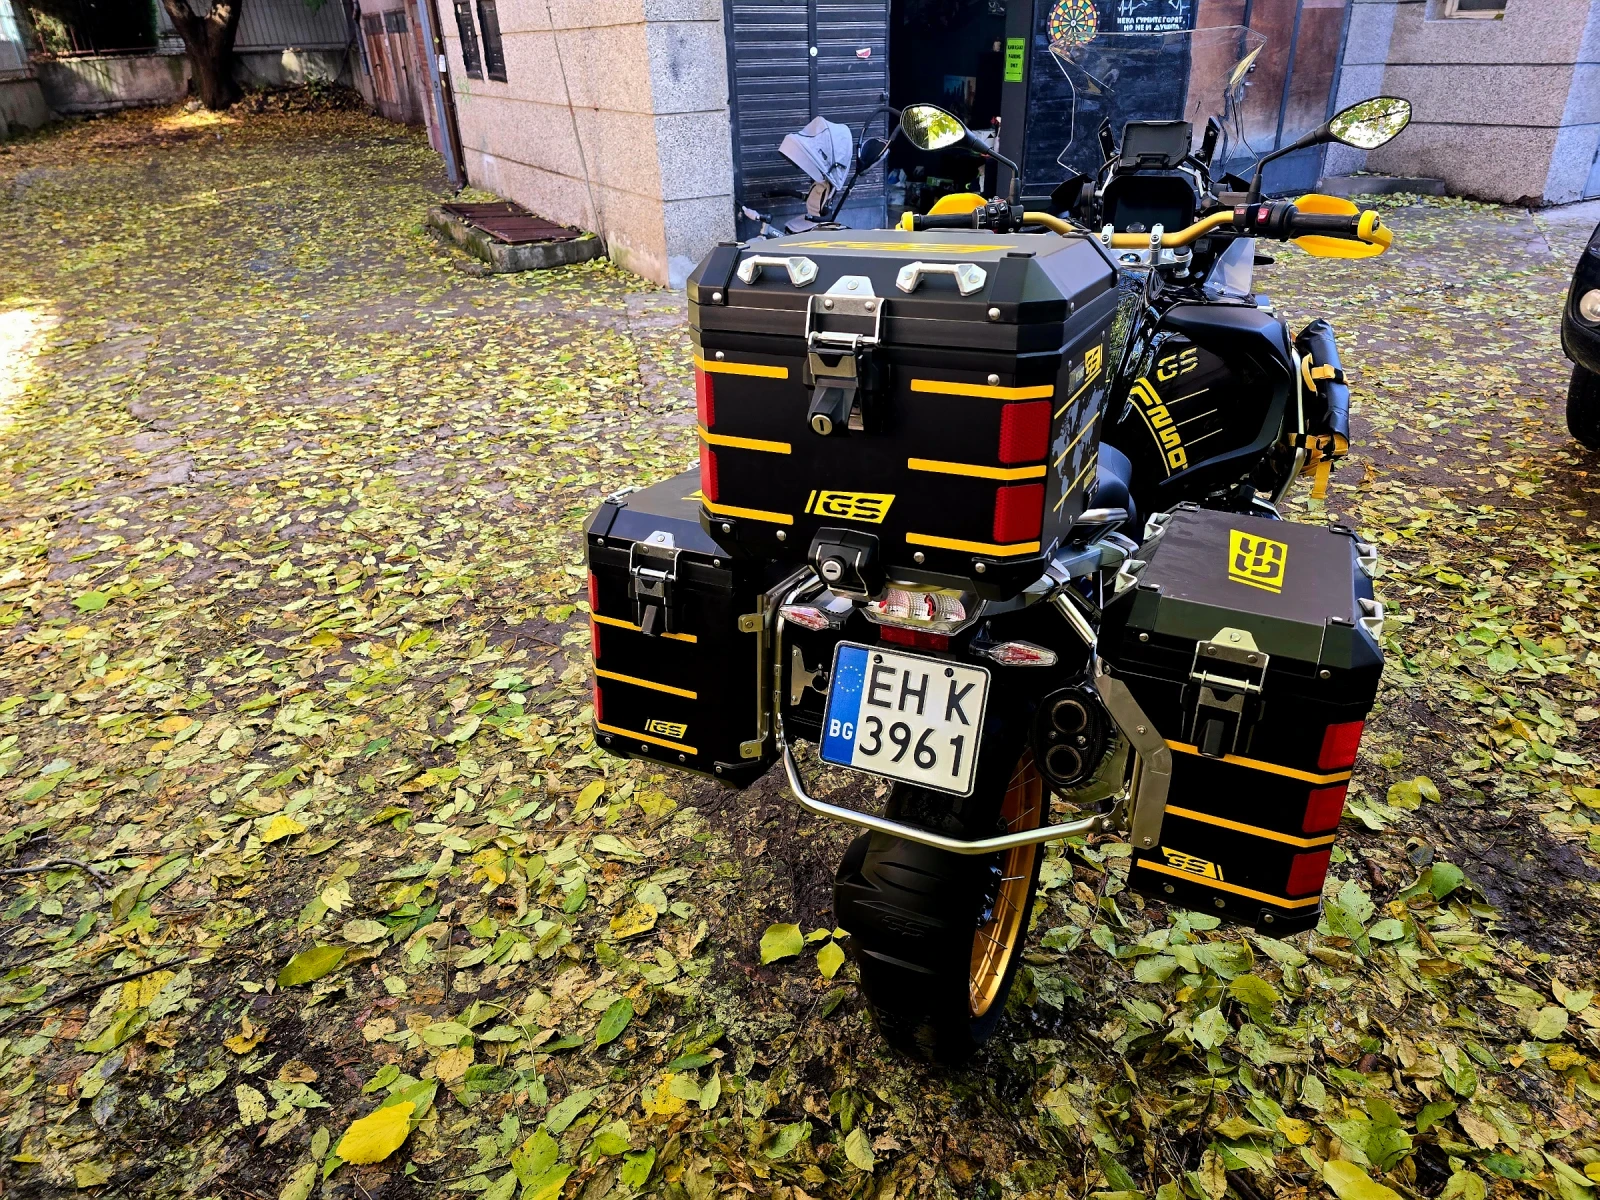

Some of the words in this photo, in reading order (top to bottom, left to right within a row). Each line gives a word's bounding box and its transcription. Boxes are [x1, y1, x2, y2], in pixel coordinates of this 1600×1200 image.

[1157, 347, 1199, 382] GS
[822, 494, 883, 520] GS
[867, 664, 929, 715] EH
[945, 680, 976, 726] K
[829, 719, 854, 740] BG
[859, 715, 965, 777] 3961
